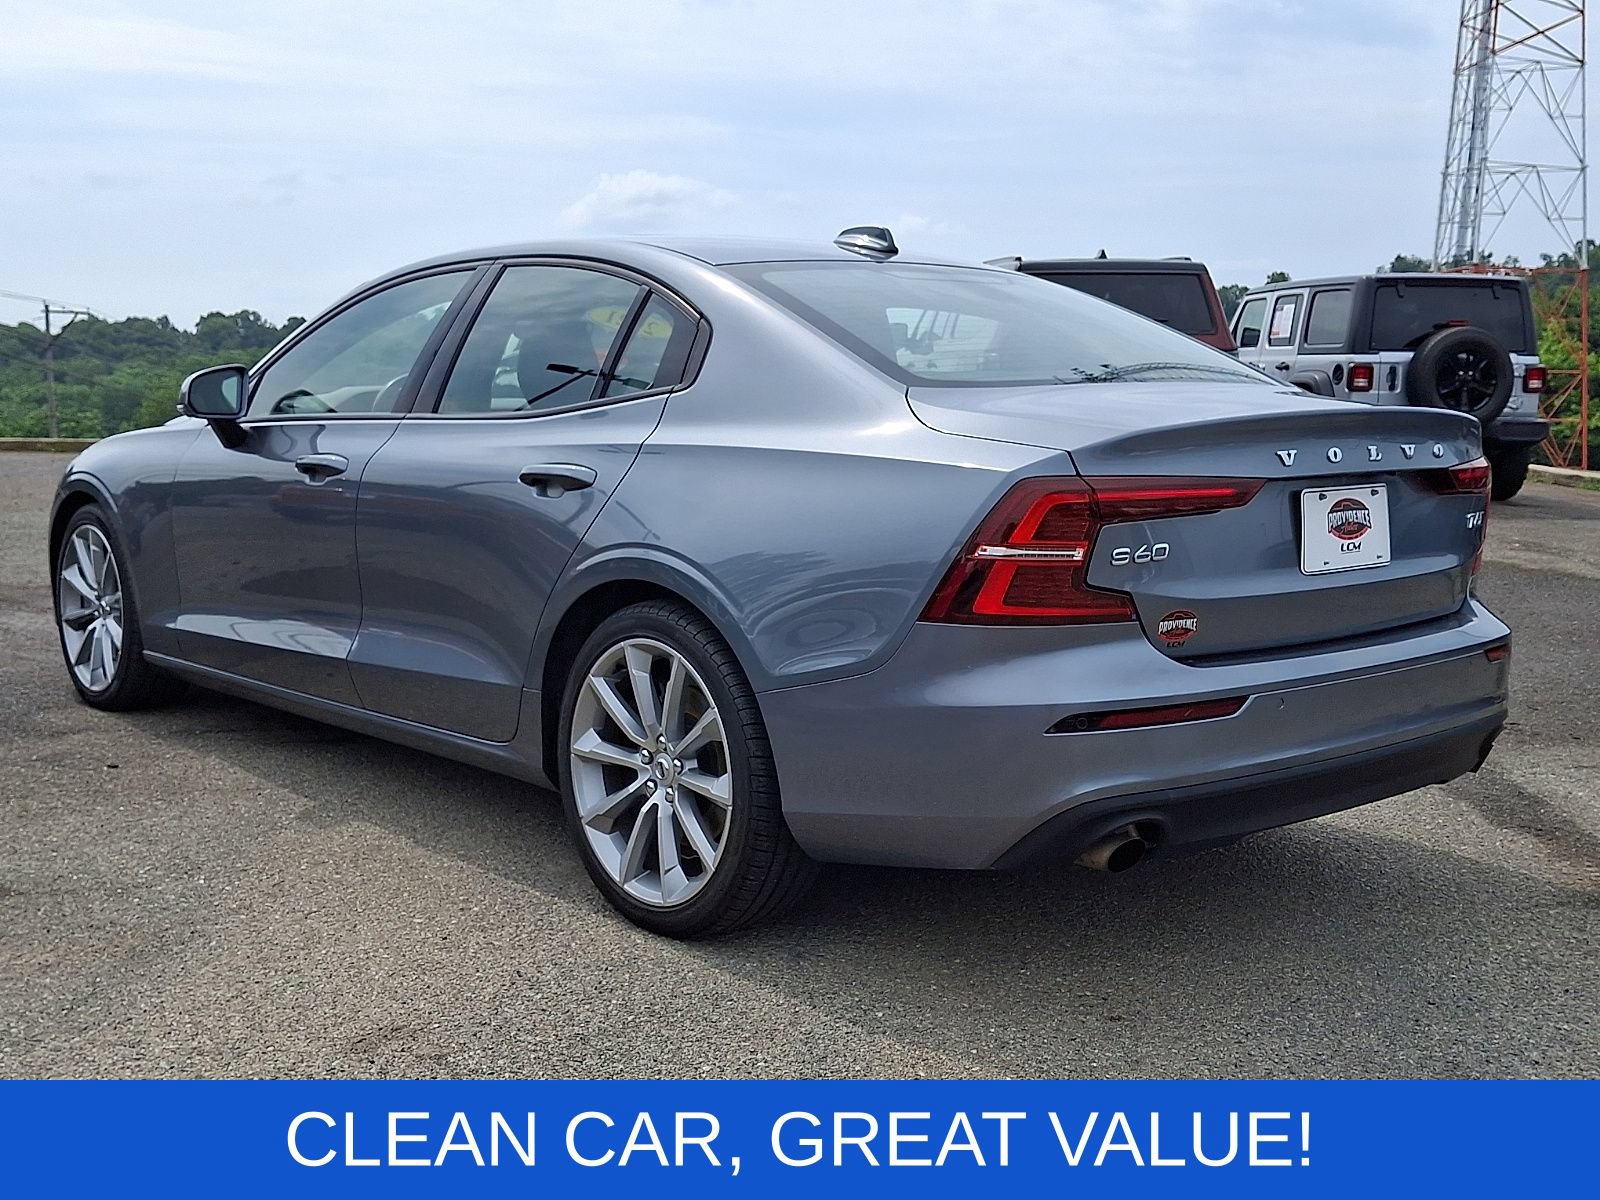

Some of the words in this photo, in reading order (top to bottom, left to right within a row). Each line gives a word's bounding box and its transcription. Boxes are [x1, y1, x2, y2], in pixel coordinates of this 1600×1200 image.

[1276, 443, 1445, 466] VOLVO
[1328, 508, 1372, 532] PROVIDENCE
[1110, 542, 1170, 566] S60
[1340, 541, 1362, 552] LCM
[1158, 618, 1198, 635] PROVIDENCE
